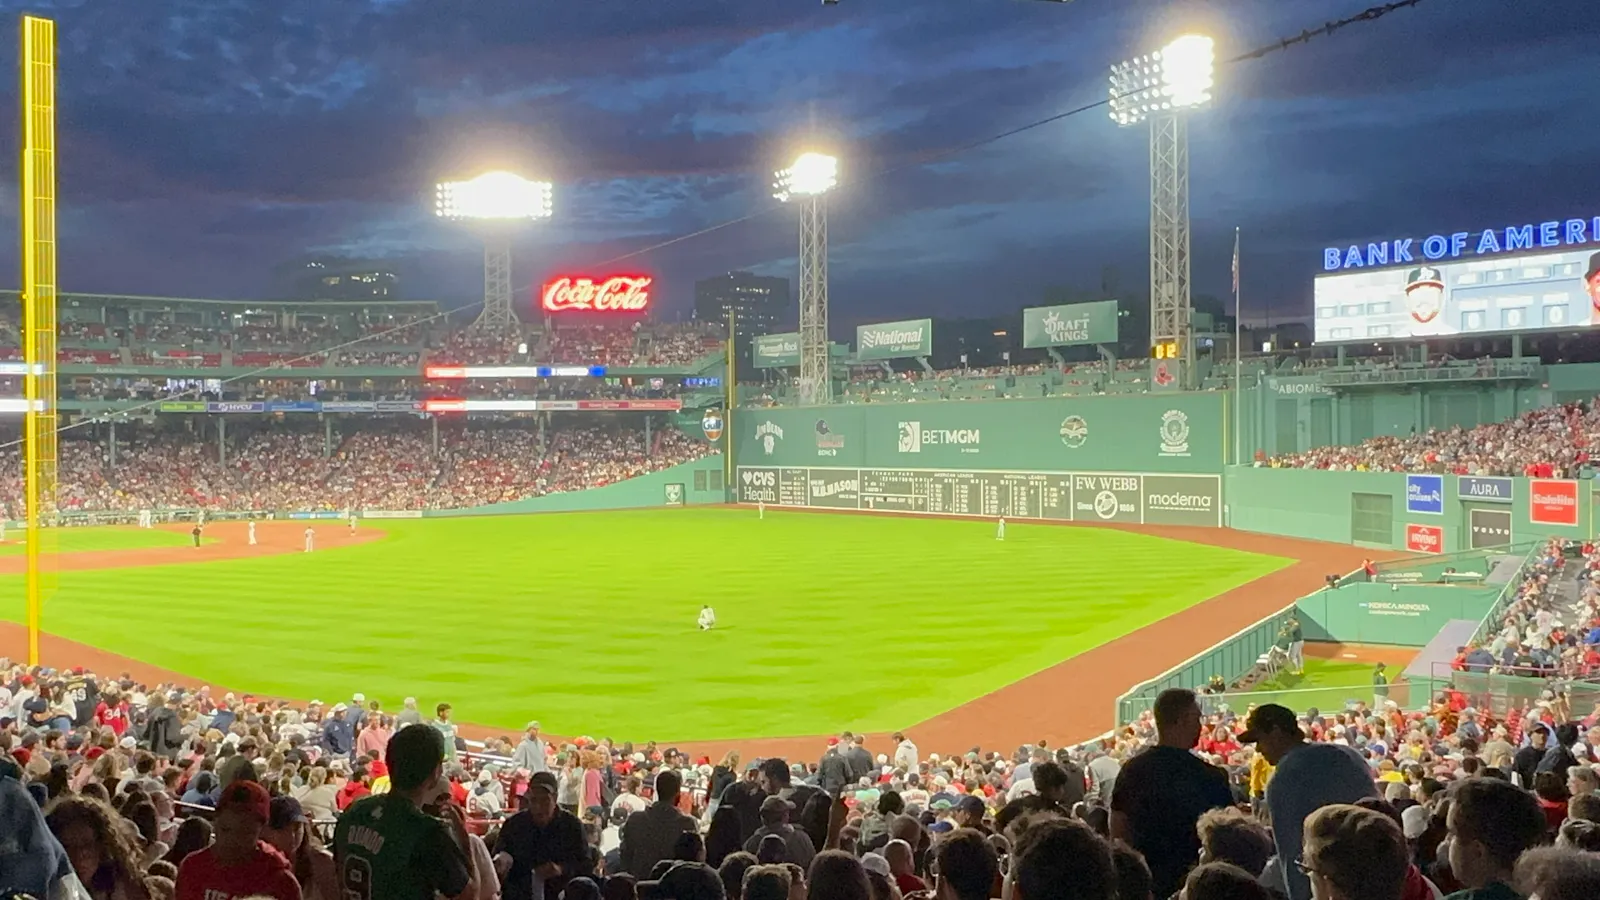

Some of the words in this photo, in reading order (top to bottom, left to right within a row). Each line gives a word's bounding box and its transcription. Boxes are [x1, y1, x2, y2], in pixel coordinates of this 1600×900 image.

[1324, 238, 1414, 271] BANK
[1423, 232, 1468, 259] OF
[1045, 318, 1090, 334] DRAFT
[874, 327, 923, 346] National
[1050, 330, 1089, 342] KINGS
[922, 429, 980, 444] BETMGM
[752, 471, 775, 486] CVS
[1099, 477, 1138, 491] WEBB
[744, 486, 775, 501] Health
[1149, 492, 1212, 507] moderna
[1473, 526, 1509, 535] VOLVO
[104, 707, 121, 720] 34
